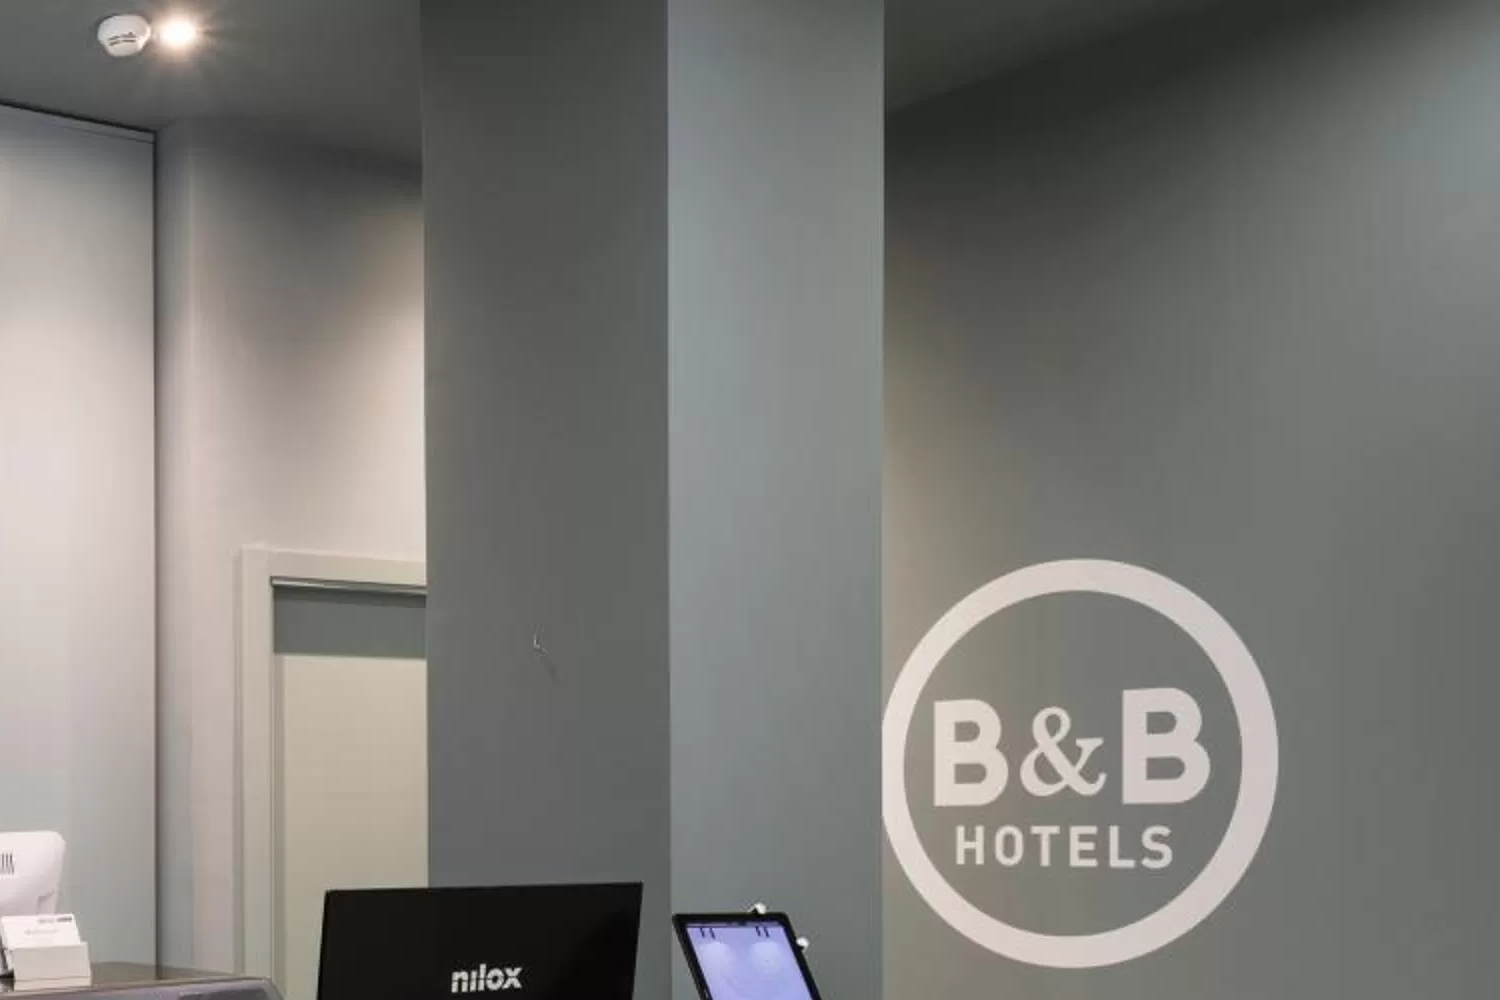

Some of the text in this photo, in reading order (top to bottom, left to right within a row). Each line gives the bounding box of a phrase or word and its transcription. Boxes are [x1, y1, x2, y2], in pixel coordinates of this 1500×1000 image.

[934, 688, 1211, 806] B&B
[956, 825, 1173, 869] HOTELS
[451, 963, 523, 993] nilox
